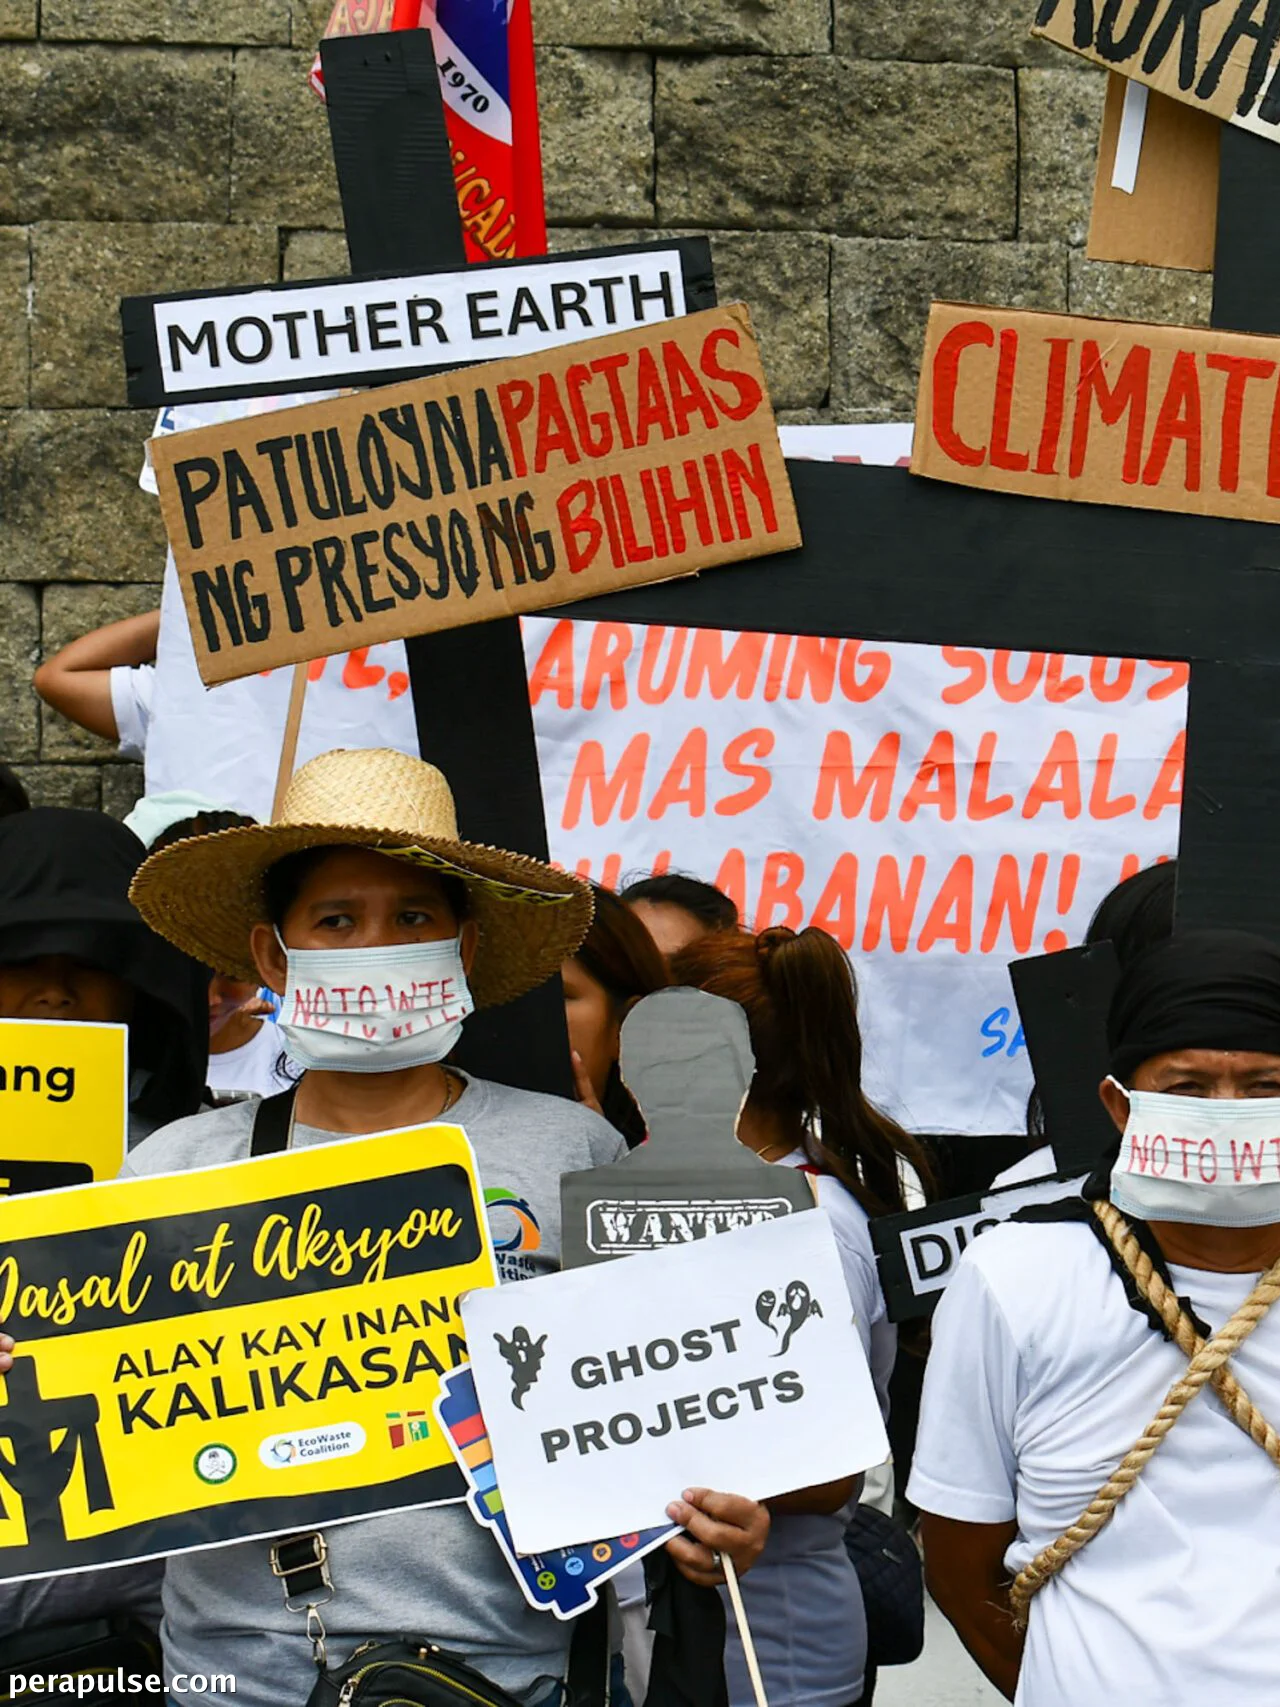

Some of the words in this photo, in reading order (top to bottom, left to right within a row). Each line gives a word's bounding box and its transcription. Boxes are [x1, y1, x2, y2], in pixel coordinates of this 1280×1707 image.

[438, 57, 490, 113] 1970
[167, 298, 449, 372] MOTHER
[468, 272, 676, 341] EARTH
[173, 406, 433, 550] PATULOY
[427, 388, 513, 497] NA
[497, 328, 763, 478] PAGTAAS
[192, 563, 271, 653] NG
[274, 507, 479, 633] PRESYO
[478, 491, 556, 591] NG
[555, 442, 779, 575] BILIHIN
[519, 619, 892, 710] ARUMING
[562, 727, 775, 830] MAS
[813, 729, 1187, 822] MALALA
[1128, 1134, 1169, 1177] NO
[1172, 1137, 1217, 1184] TO
[170, 1222, 235, 1298] at
[253, 1203, 462, 1286] Aksyon
[112, 1336, 226, 1383] ALAY
[241, 1318, 327, 1360] KAY
[570, 1318, 742, 1391] GHOST
[297, 1430, 352, 1447] EcoWaste
[299, 1440, 350, 1457] Coalition
[540, 1369, 806, 1464] PROJECTS
